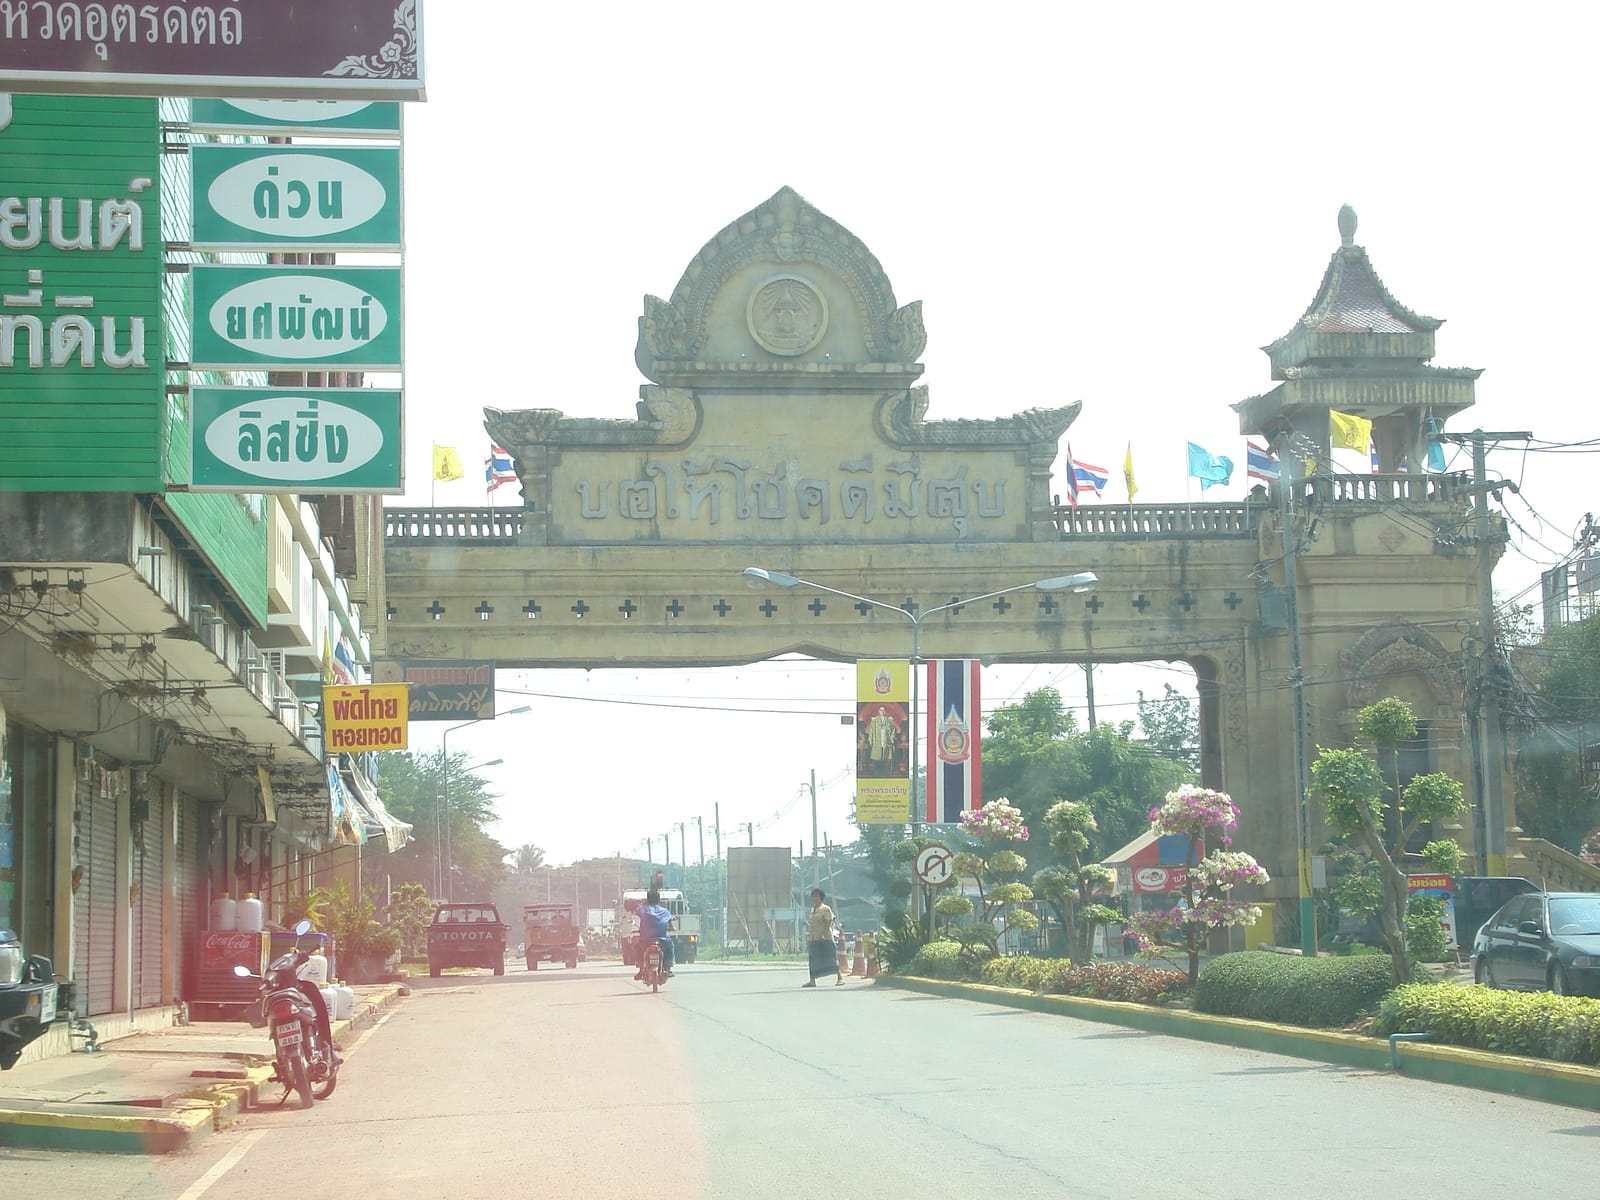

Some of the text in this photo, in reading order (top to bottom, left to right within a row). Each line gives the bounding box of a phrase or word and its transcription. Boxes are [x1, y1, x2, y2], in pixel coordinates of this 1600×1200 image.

[253, 166, 343, 220] ด่วน
[226, 293, 373, 341] ยศพัฒน์
[331, 726, 402, 747] หอยทอด
[442, 931, 493, 941] TOYOTA
